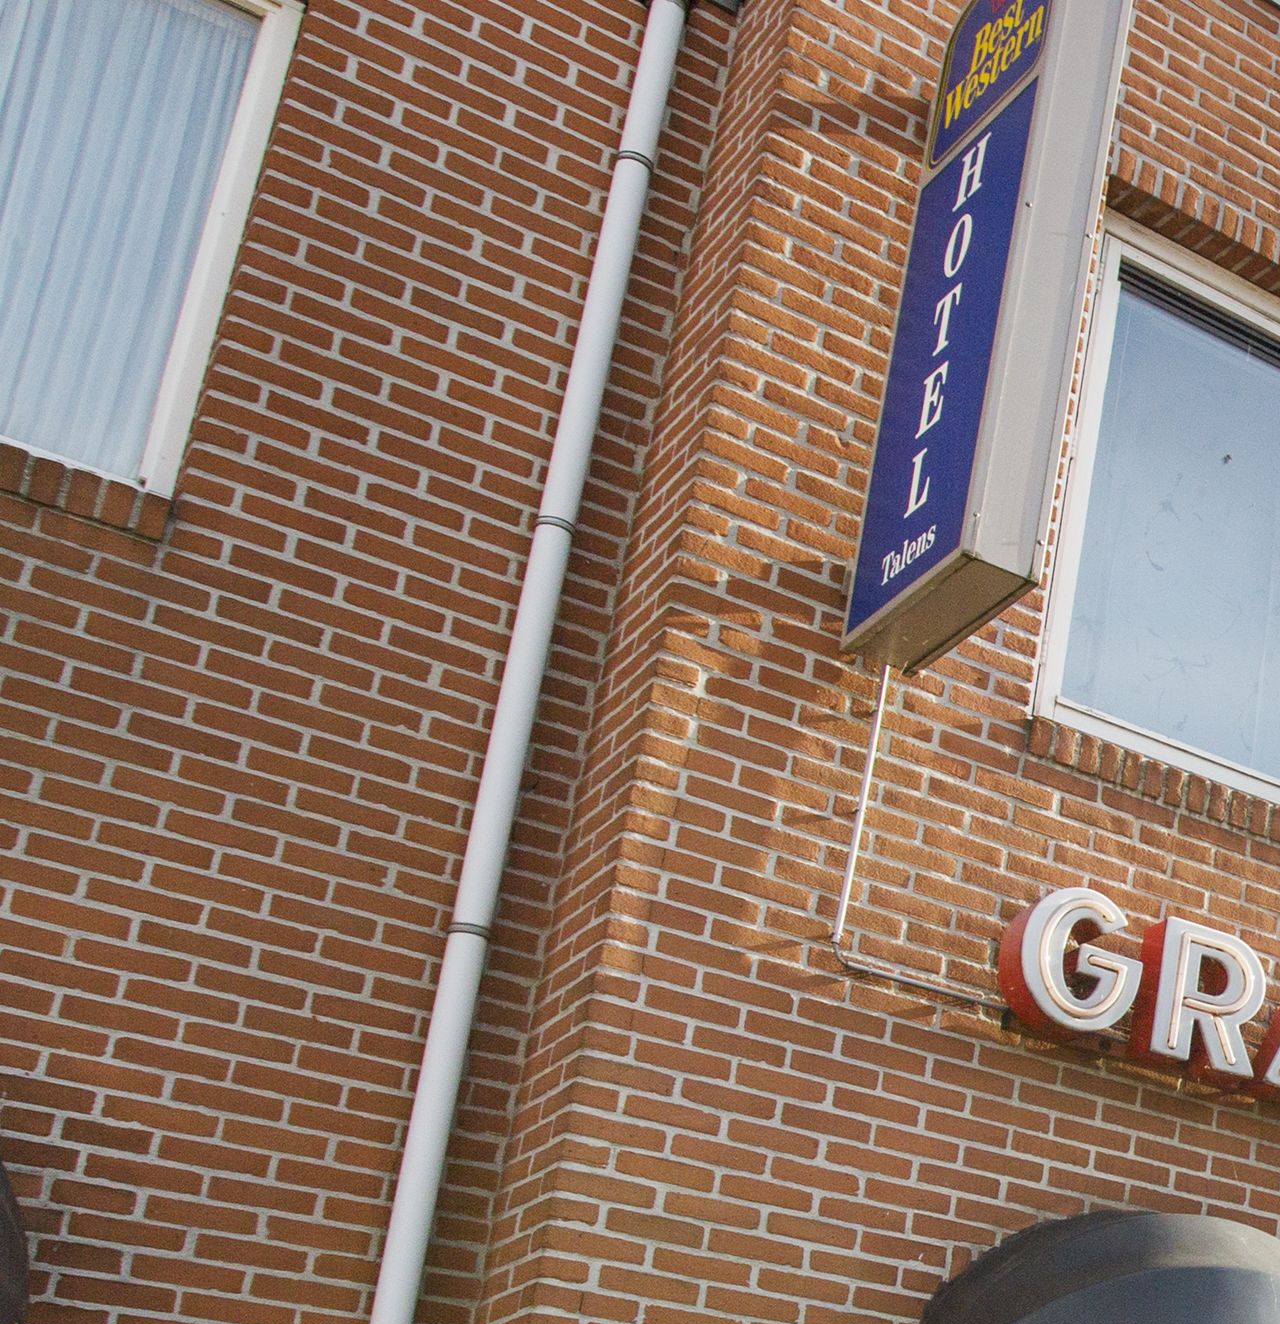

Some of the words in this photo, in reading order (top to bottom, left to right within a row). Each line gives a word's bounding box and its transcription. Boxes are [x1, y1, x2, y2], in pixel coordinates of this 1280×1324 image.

[944, 5, 1044, 129] Western
[966, 0, 1024, 79] Best
[903, 132, 992, 519] HOTEL
[881, 524, 937, 586] Talens
